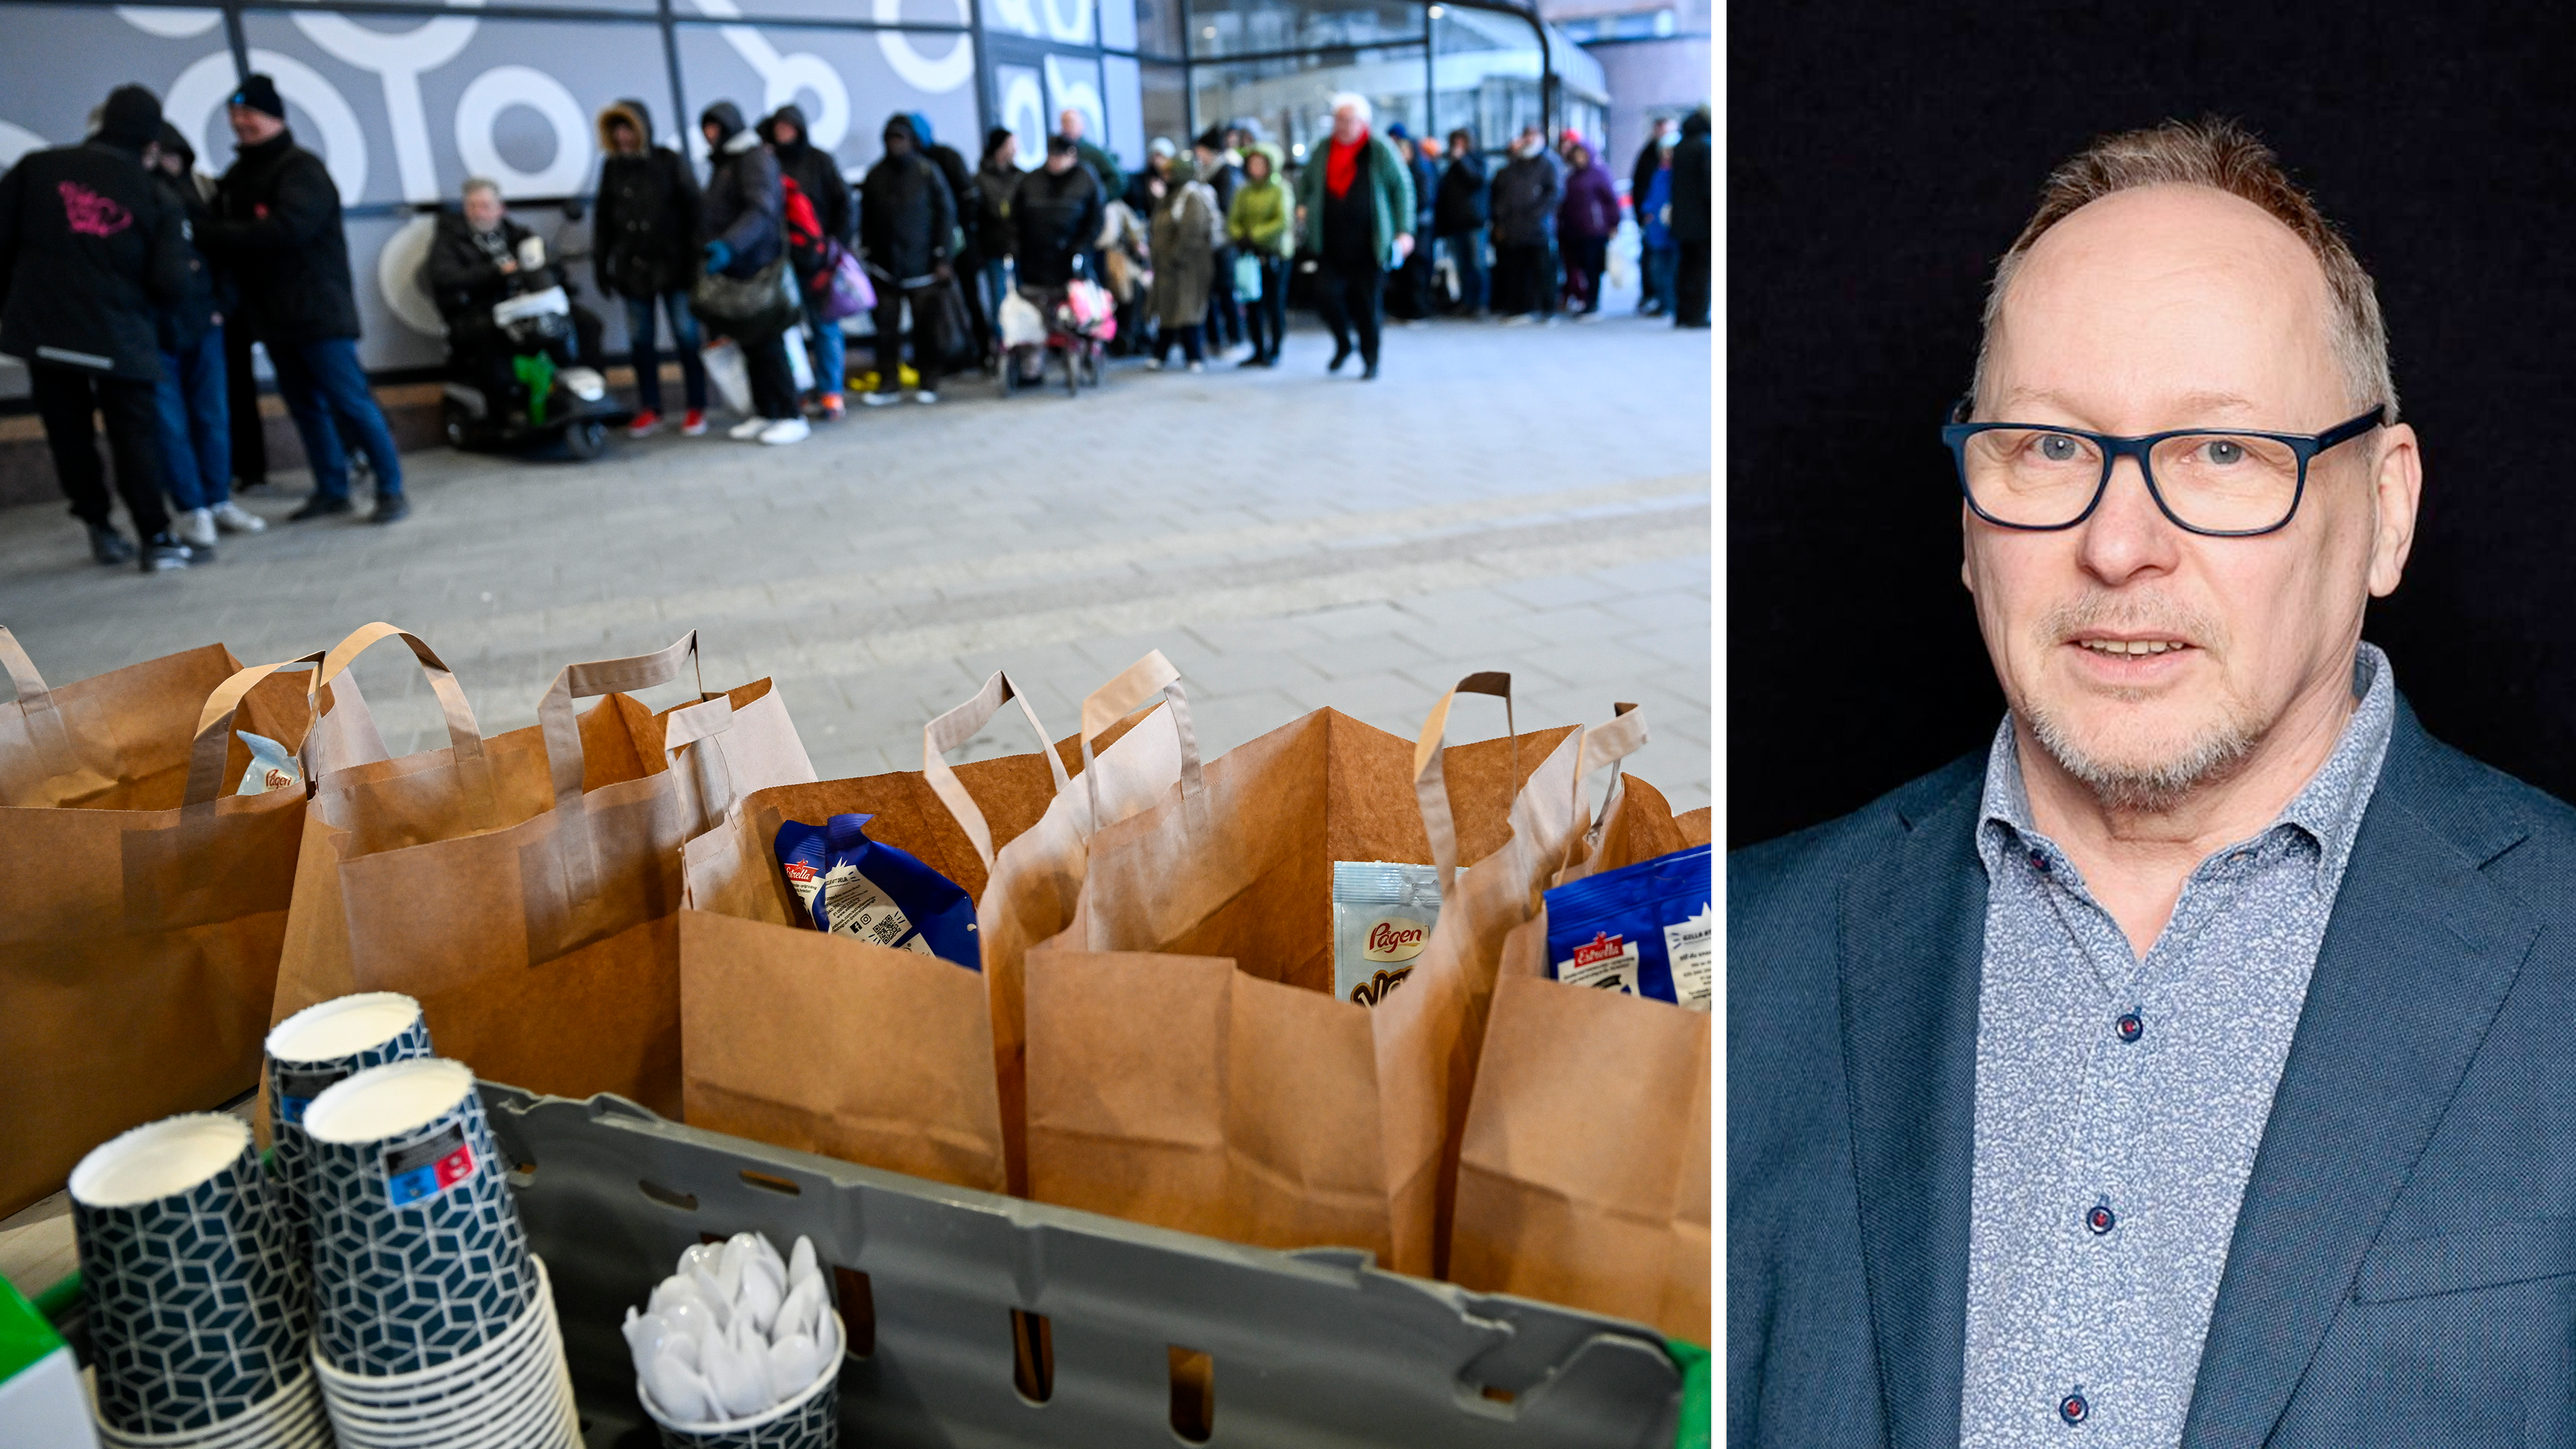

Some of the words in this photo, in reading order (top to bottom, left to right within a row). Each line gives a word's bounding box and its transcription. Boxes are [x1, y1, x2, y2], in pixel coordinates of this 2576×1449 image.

[266, 769, 292, 789] Pågen
[786, 867, 810, 880] Estrella
[1369, 922, 1423, 953] Pågen
[1577, 942, 1620, 965] Estrella
